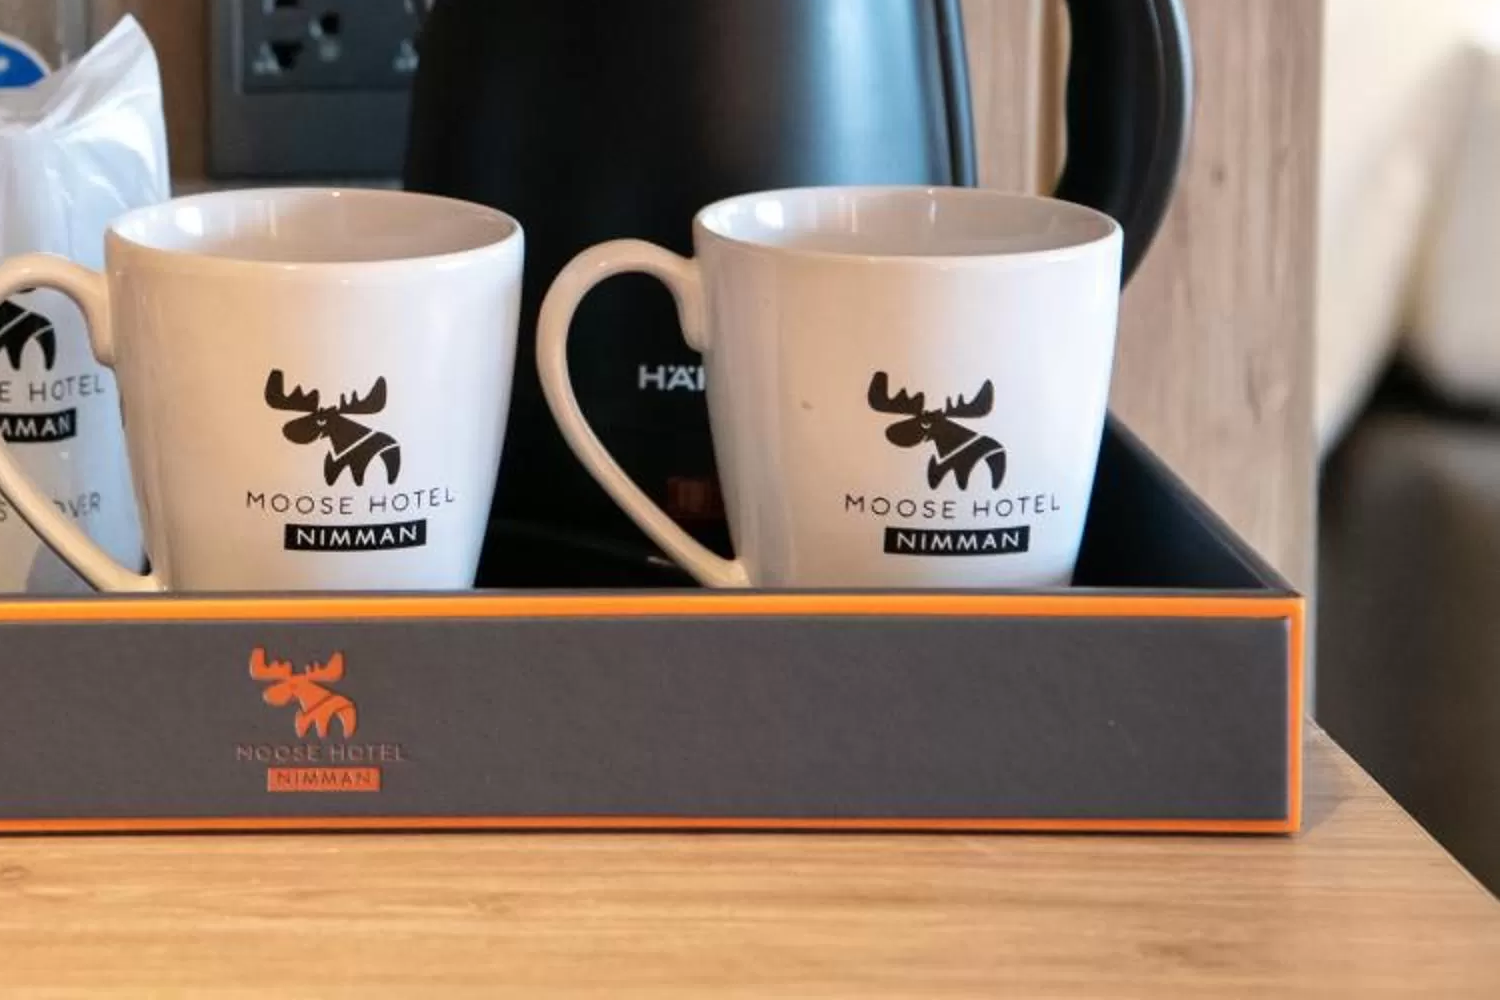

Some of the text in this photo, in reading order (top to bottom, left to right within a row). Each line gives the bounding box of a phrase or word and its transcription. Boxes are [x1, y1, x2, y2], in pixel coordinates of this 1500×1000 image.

[29, 375, 106, 402] HOTEL
[246, 487, 455, 515] MOOSE HOTEL
[845, 494, 1061, 519] MOOSE HOTEL
[296, 524, 418, 547] NIMMAN
[896, 531, 1021, 551] NIMMAN
[235, 742, 406, 763] MOOSE HOTEL
[276, 771, 372, 787] NIMMAN
